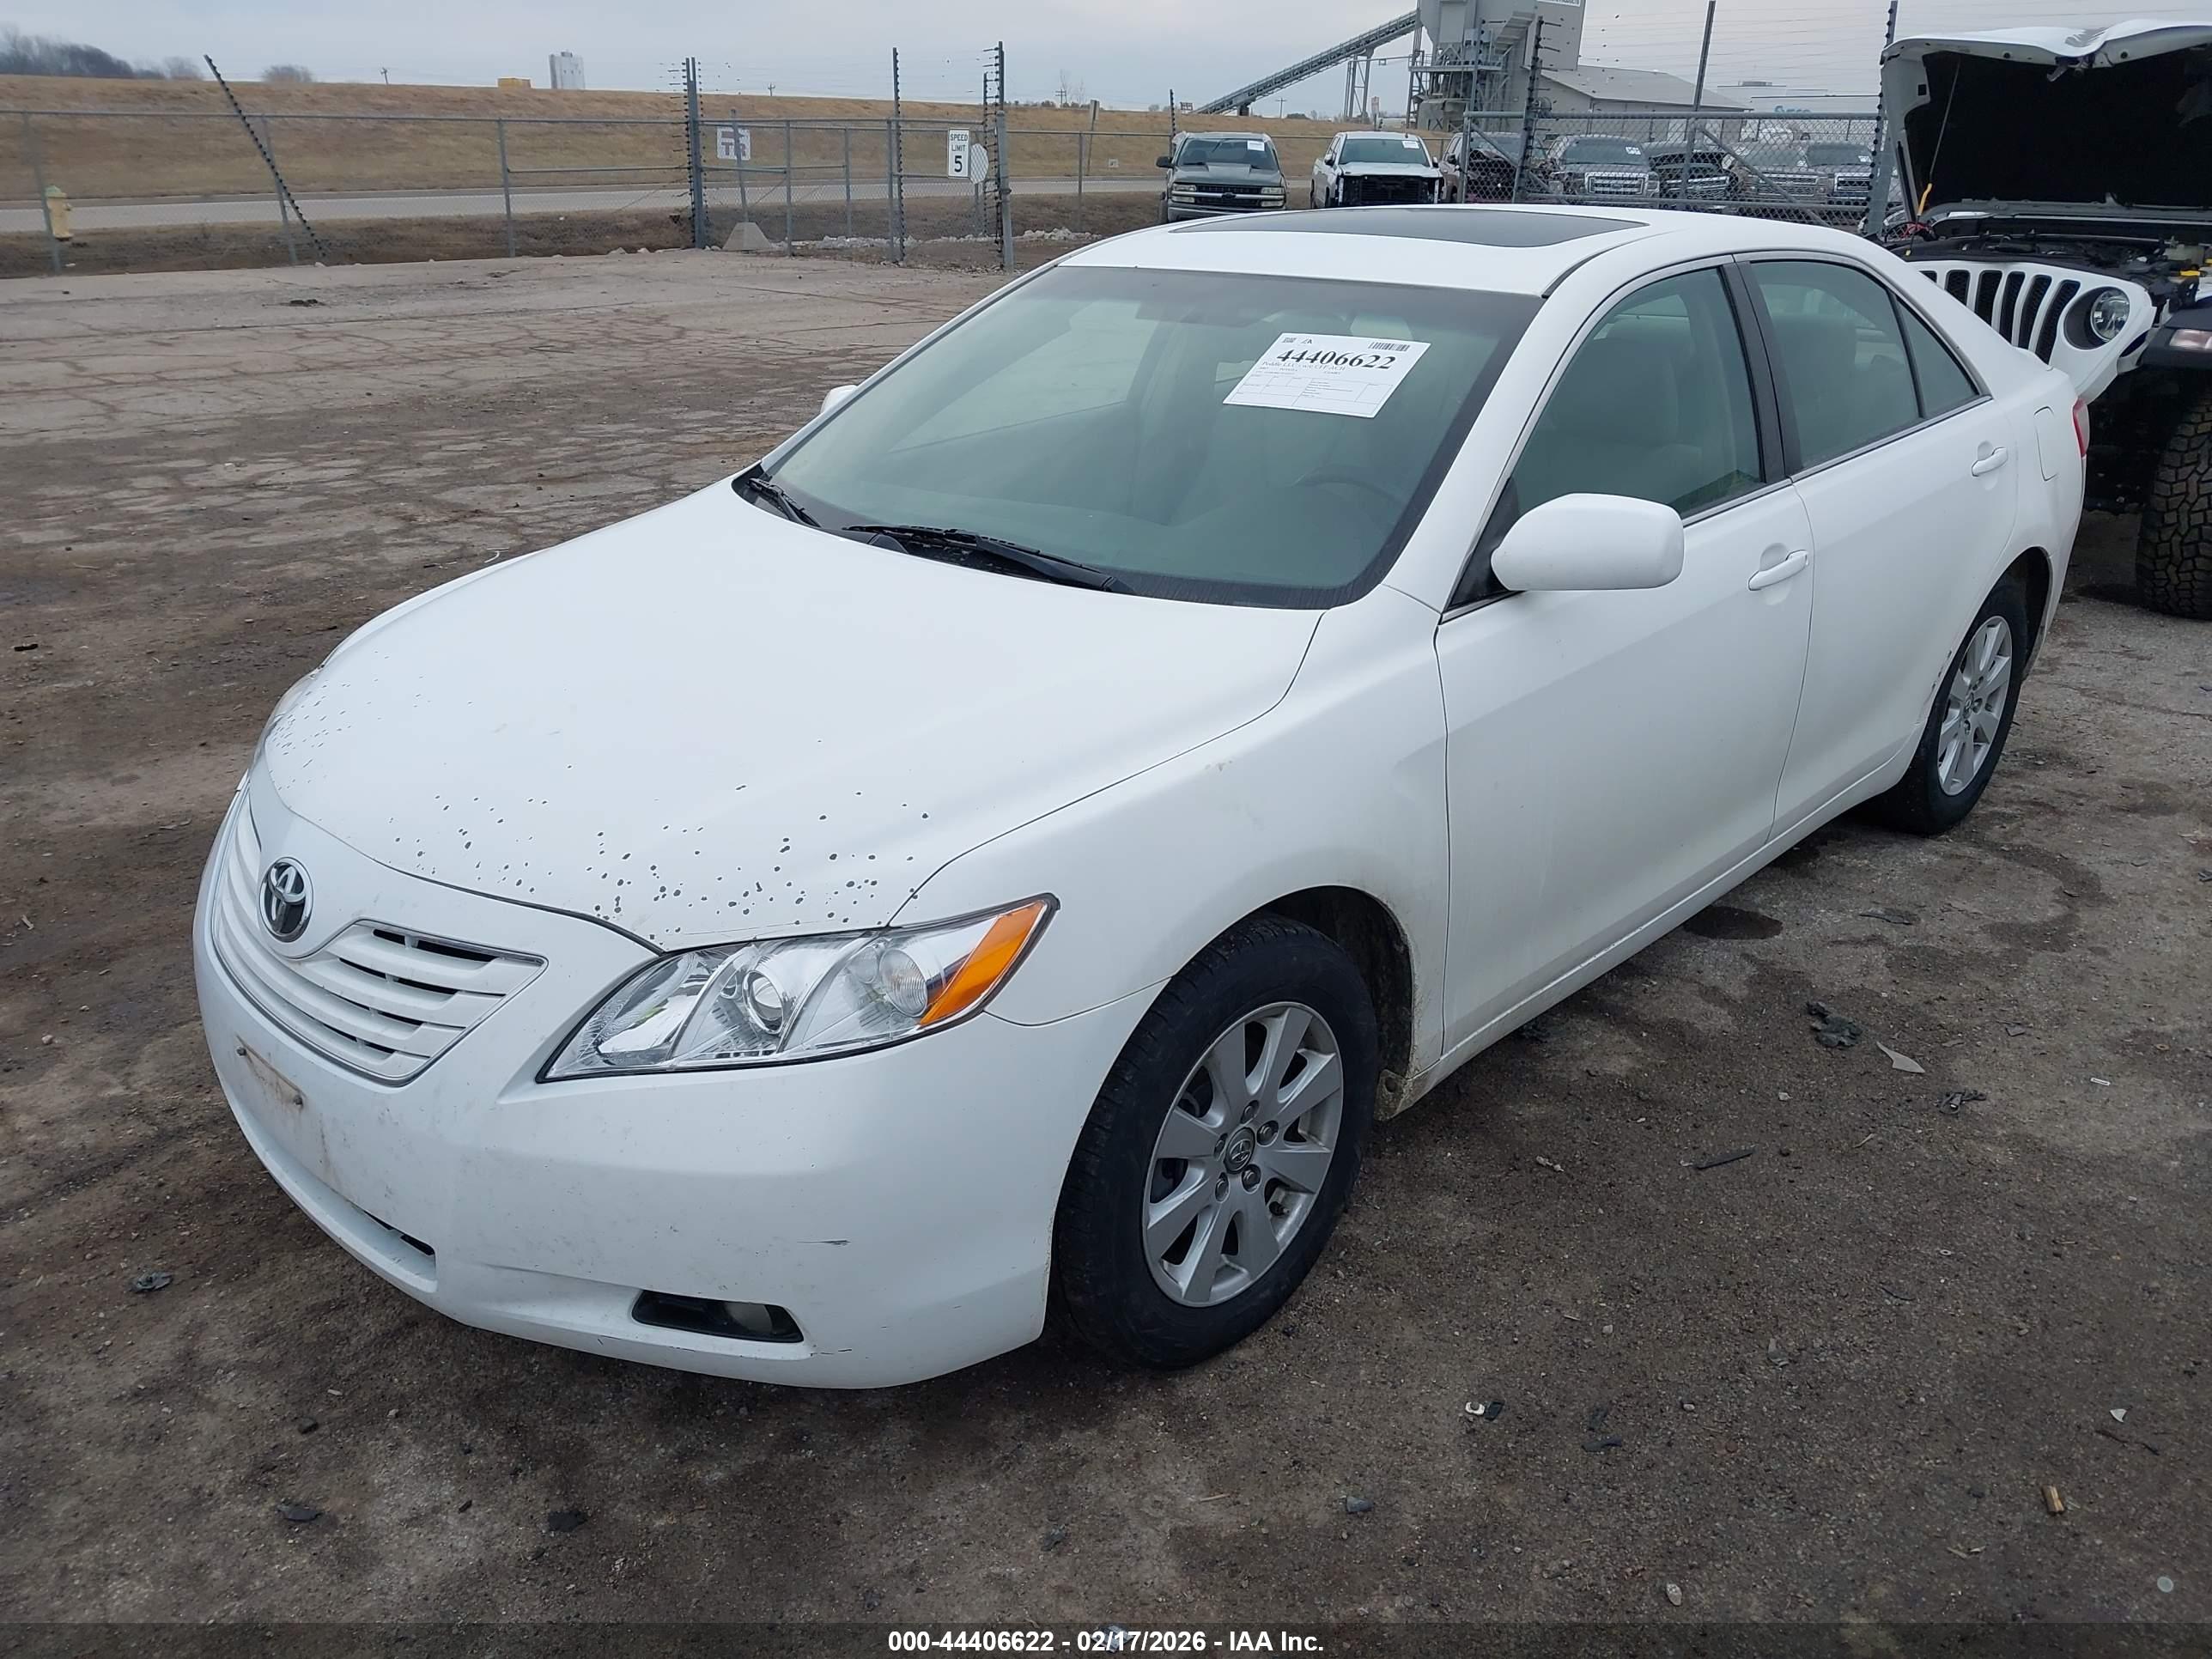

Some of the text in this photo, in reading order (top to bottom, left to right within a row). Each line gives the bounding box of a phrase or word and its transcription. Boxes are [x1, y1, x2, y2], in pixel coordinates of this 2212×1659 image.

[950, 133, 968, 142] SPEED
[954, 155, 963, 173] 5
[1276, 349, 1396, 370] 44406622
